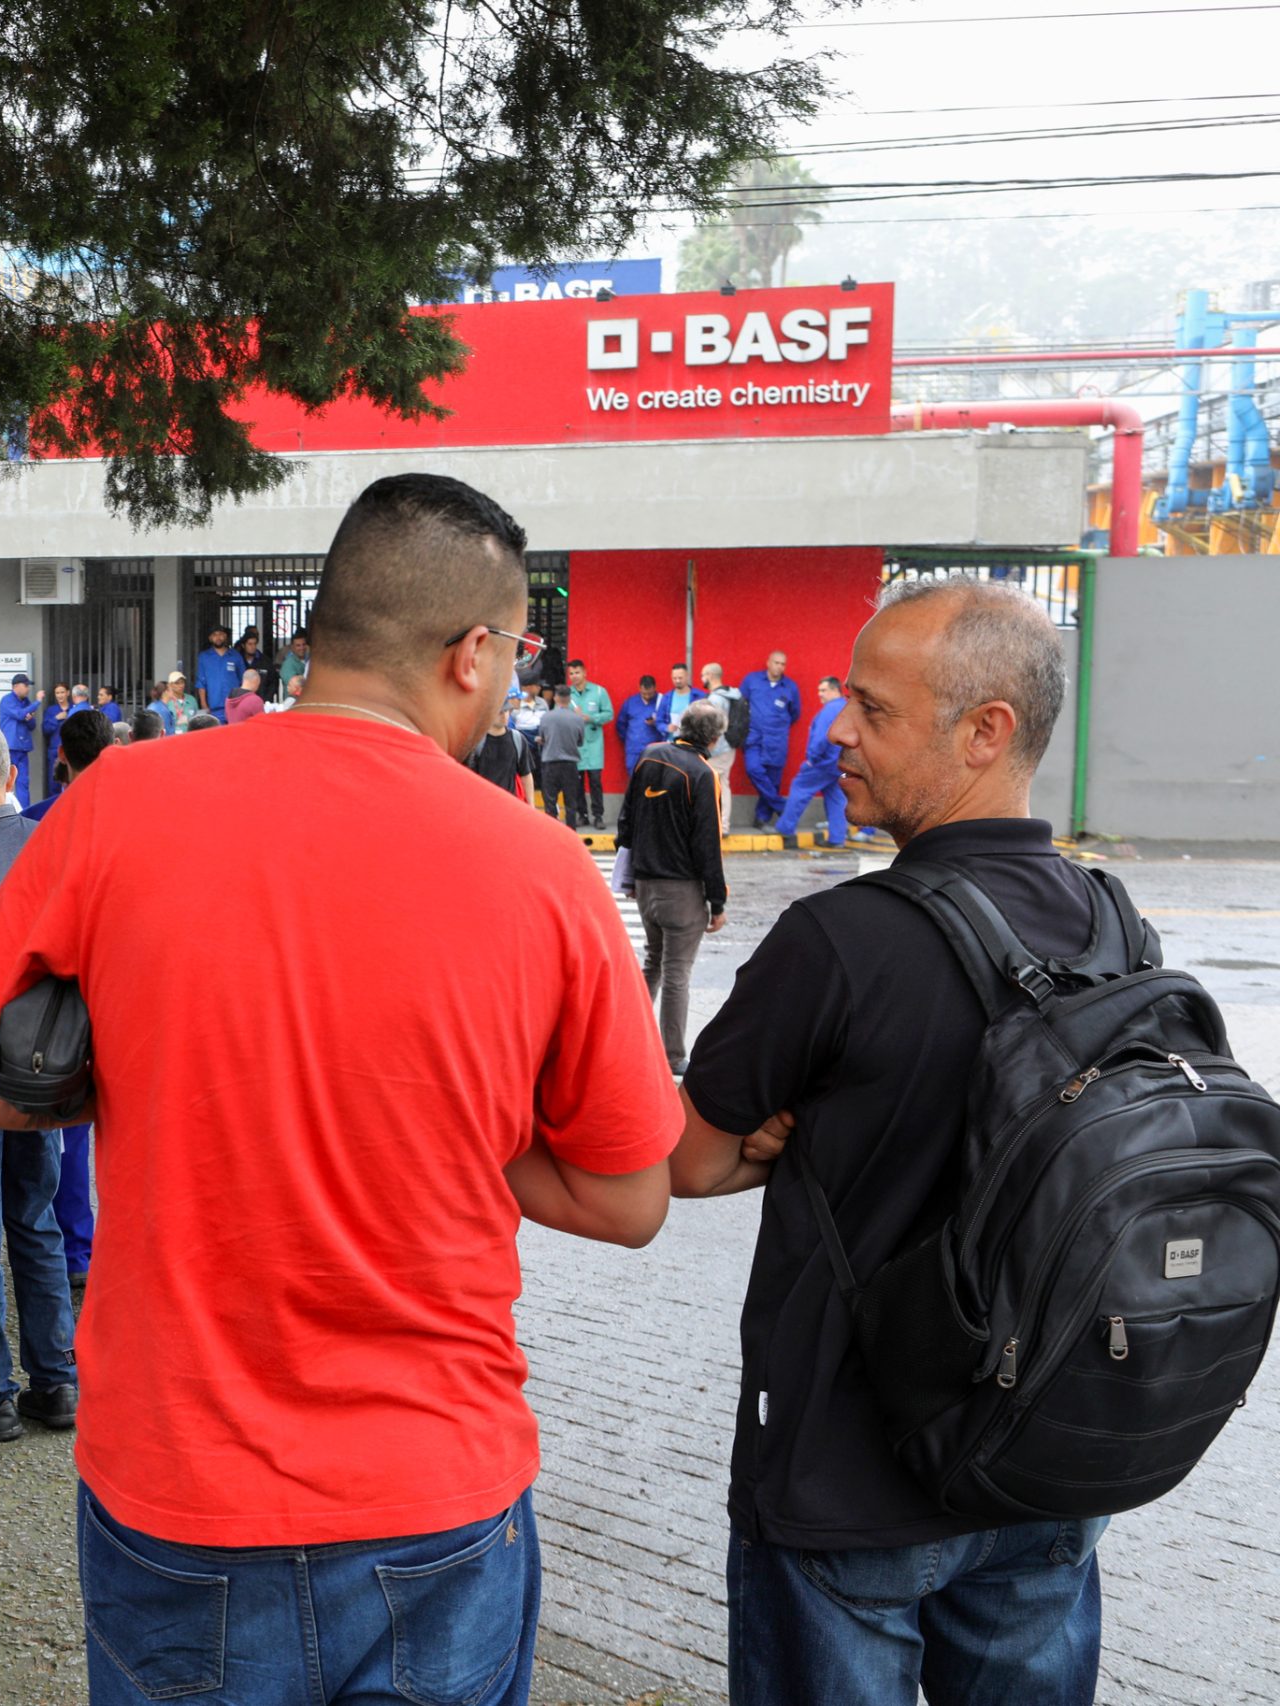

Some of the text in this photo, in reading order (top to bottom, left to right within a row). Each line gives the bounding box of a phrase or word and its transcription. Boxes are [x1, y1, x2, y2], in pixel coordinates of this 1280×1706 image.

[685, 307, 871, 365] BASF
[586, 379, 870, 411] We create chemistry
[1180, 1249, 1200, 1259] BASF
